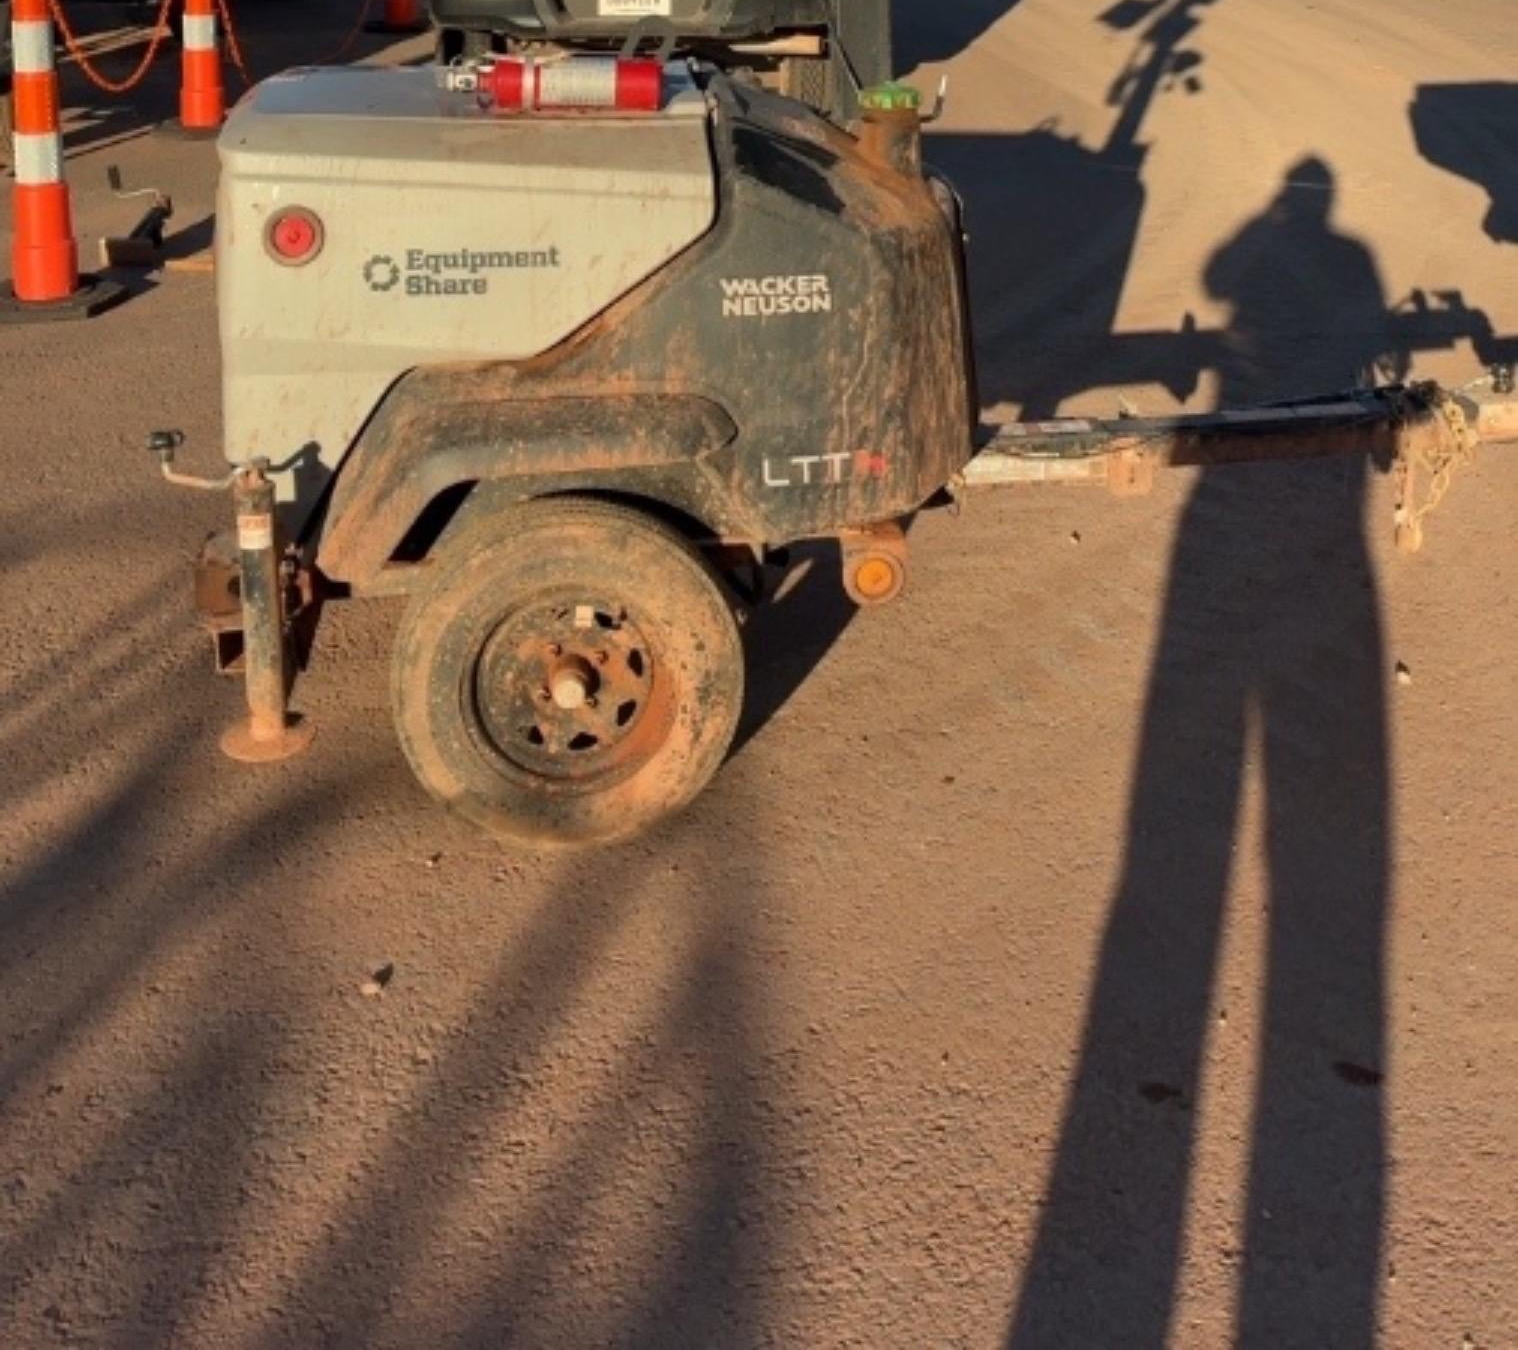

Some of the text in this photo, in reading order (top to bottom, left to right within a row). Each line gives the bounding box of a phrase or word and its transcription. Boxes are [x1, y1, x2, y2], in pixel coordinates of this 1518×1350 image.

[405, 246, 561, 273] Equipment
[405, 275, 488, 295] Share
[720, 274, 830, 296] WACKER
[722, 292, 832, 316] NEUSON
